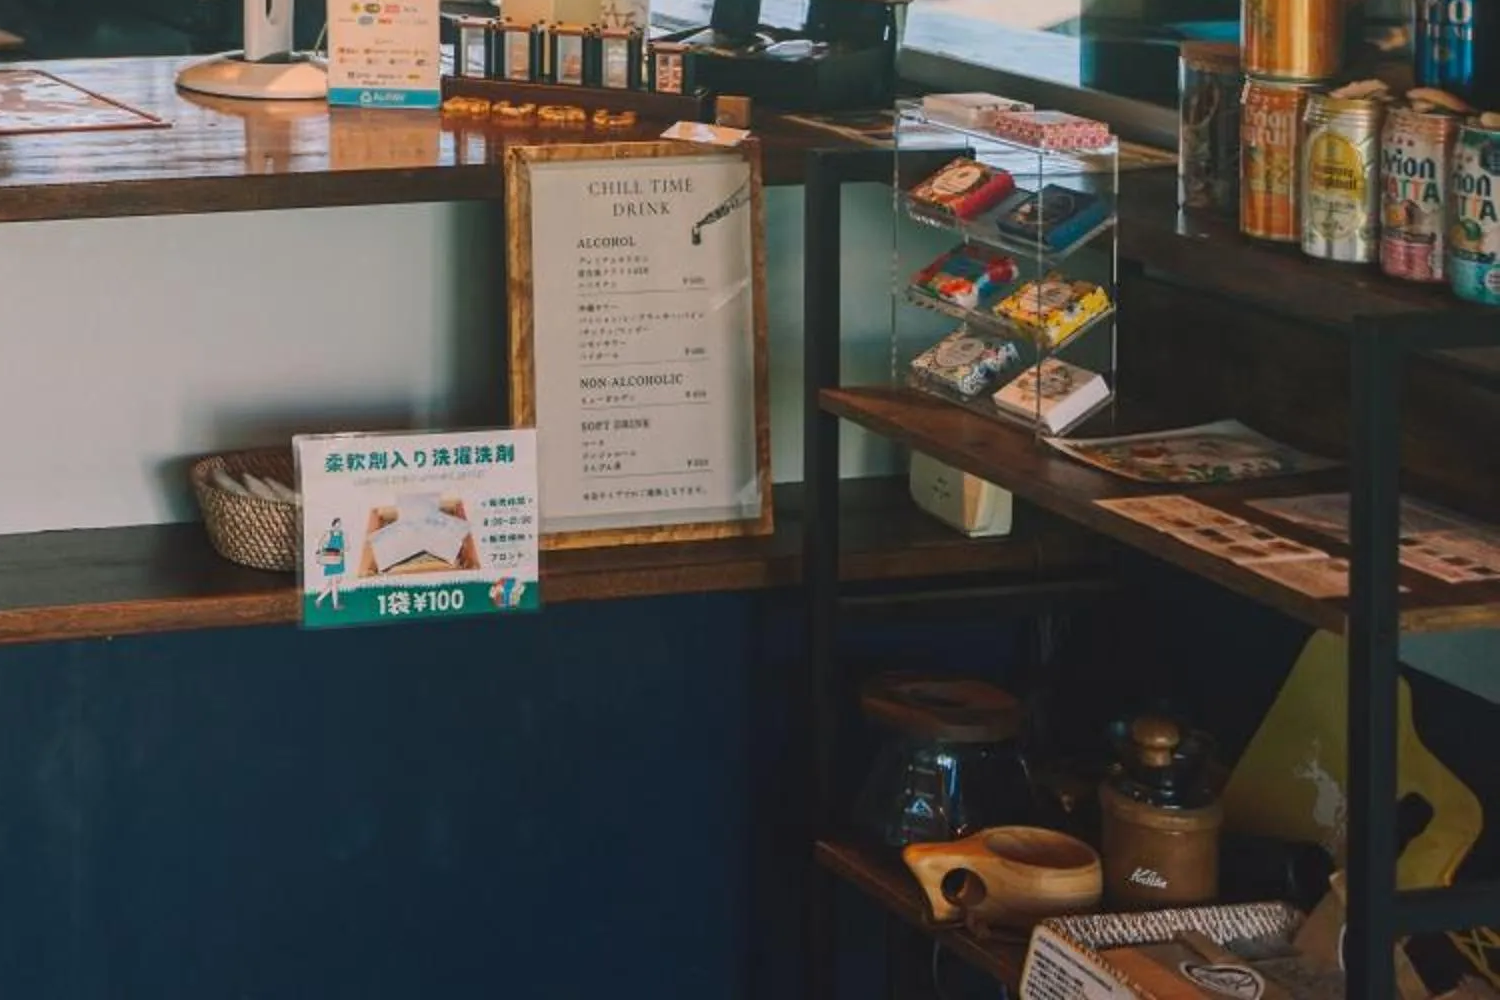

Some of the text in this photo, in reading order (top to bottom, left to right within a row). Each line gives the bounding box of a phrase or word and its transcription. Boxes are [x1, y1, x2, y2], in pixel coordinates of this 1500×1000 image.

[588, 177, 694, 195] CHILL TIME
[613, 202, 671, 217] DRINK
[577, 236, 636, 249] ALCOHOL
[581, 418, 650, 432] SOFT DRINK
[325, 444, 515, 473] 柔軟剤入り洗濯洗剤
